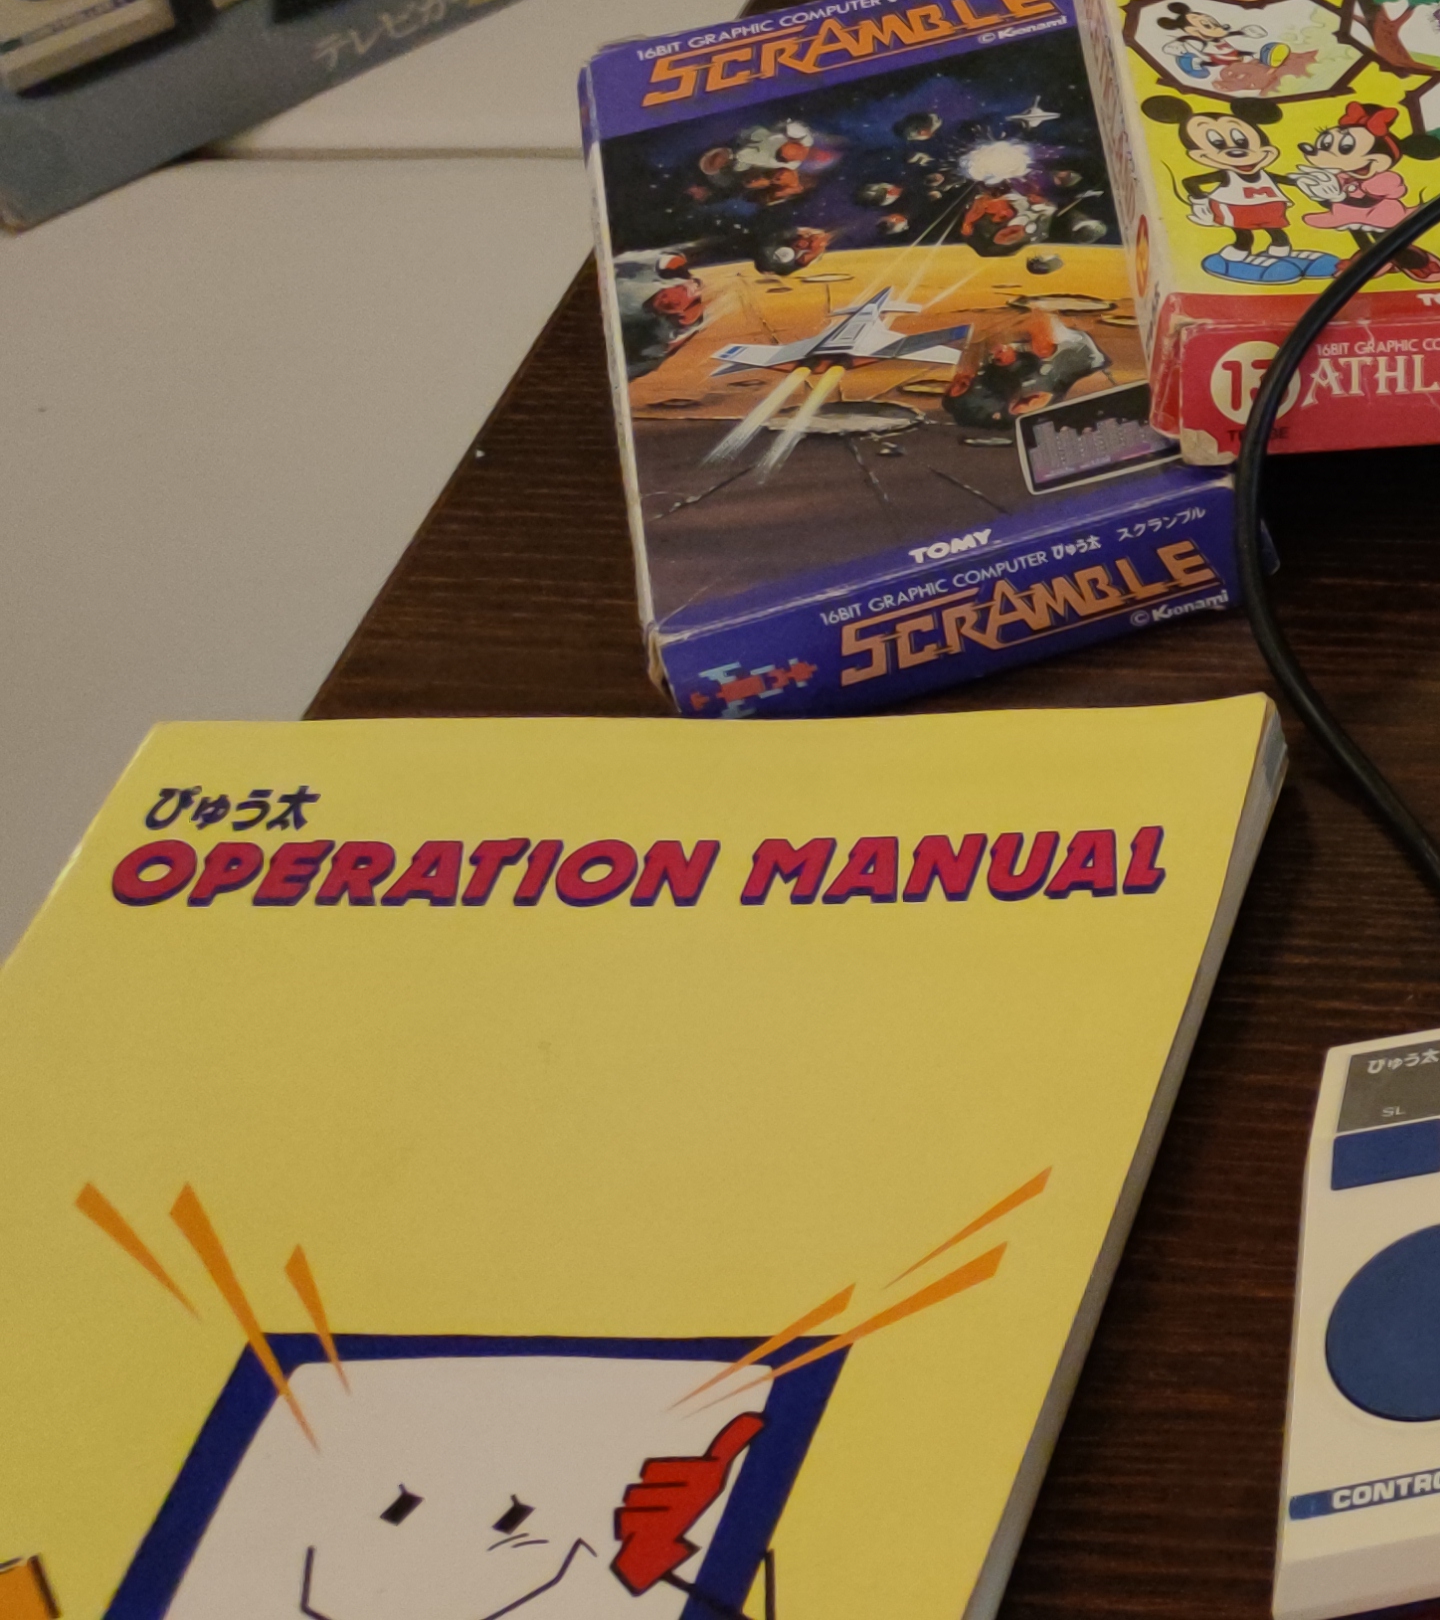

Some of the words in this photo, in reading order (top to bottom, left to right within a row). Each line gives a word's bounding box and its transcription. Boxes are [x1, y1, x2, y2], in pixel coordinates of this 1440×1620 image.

[636, 41, 682, 62] 16BIT
[687, 20, 775, 49] GRAPHIC
[1353, 336, 1420, 355] GRAPHIC
[819, 602, 864, 627] 16BIT
[868, 579, 950, 613] GRAPHIC
[952, 550, 1050, 588] COMPUTER
[1116, 504, 1207, 541] スクランブル
[909, 528, 994, 564] TOMY
[840, 537, 1222, 687] SCRAMBLE
[110, 836, 721, 908] OPERATION
[739, 826, 1167, 906] MANUAL
[1367, 1047, 1440, 1076] ぴゅう太
[1381, 1103, 1407, 1119] SL
